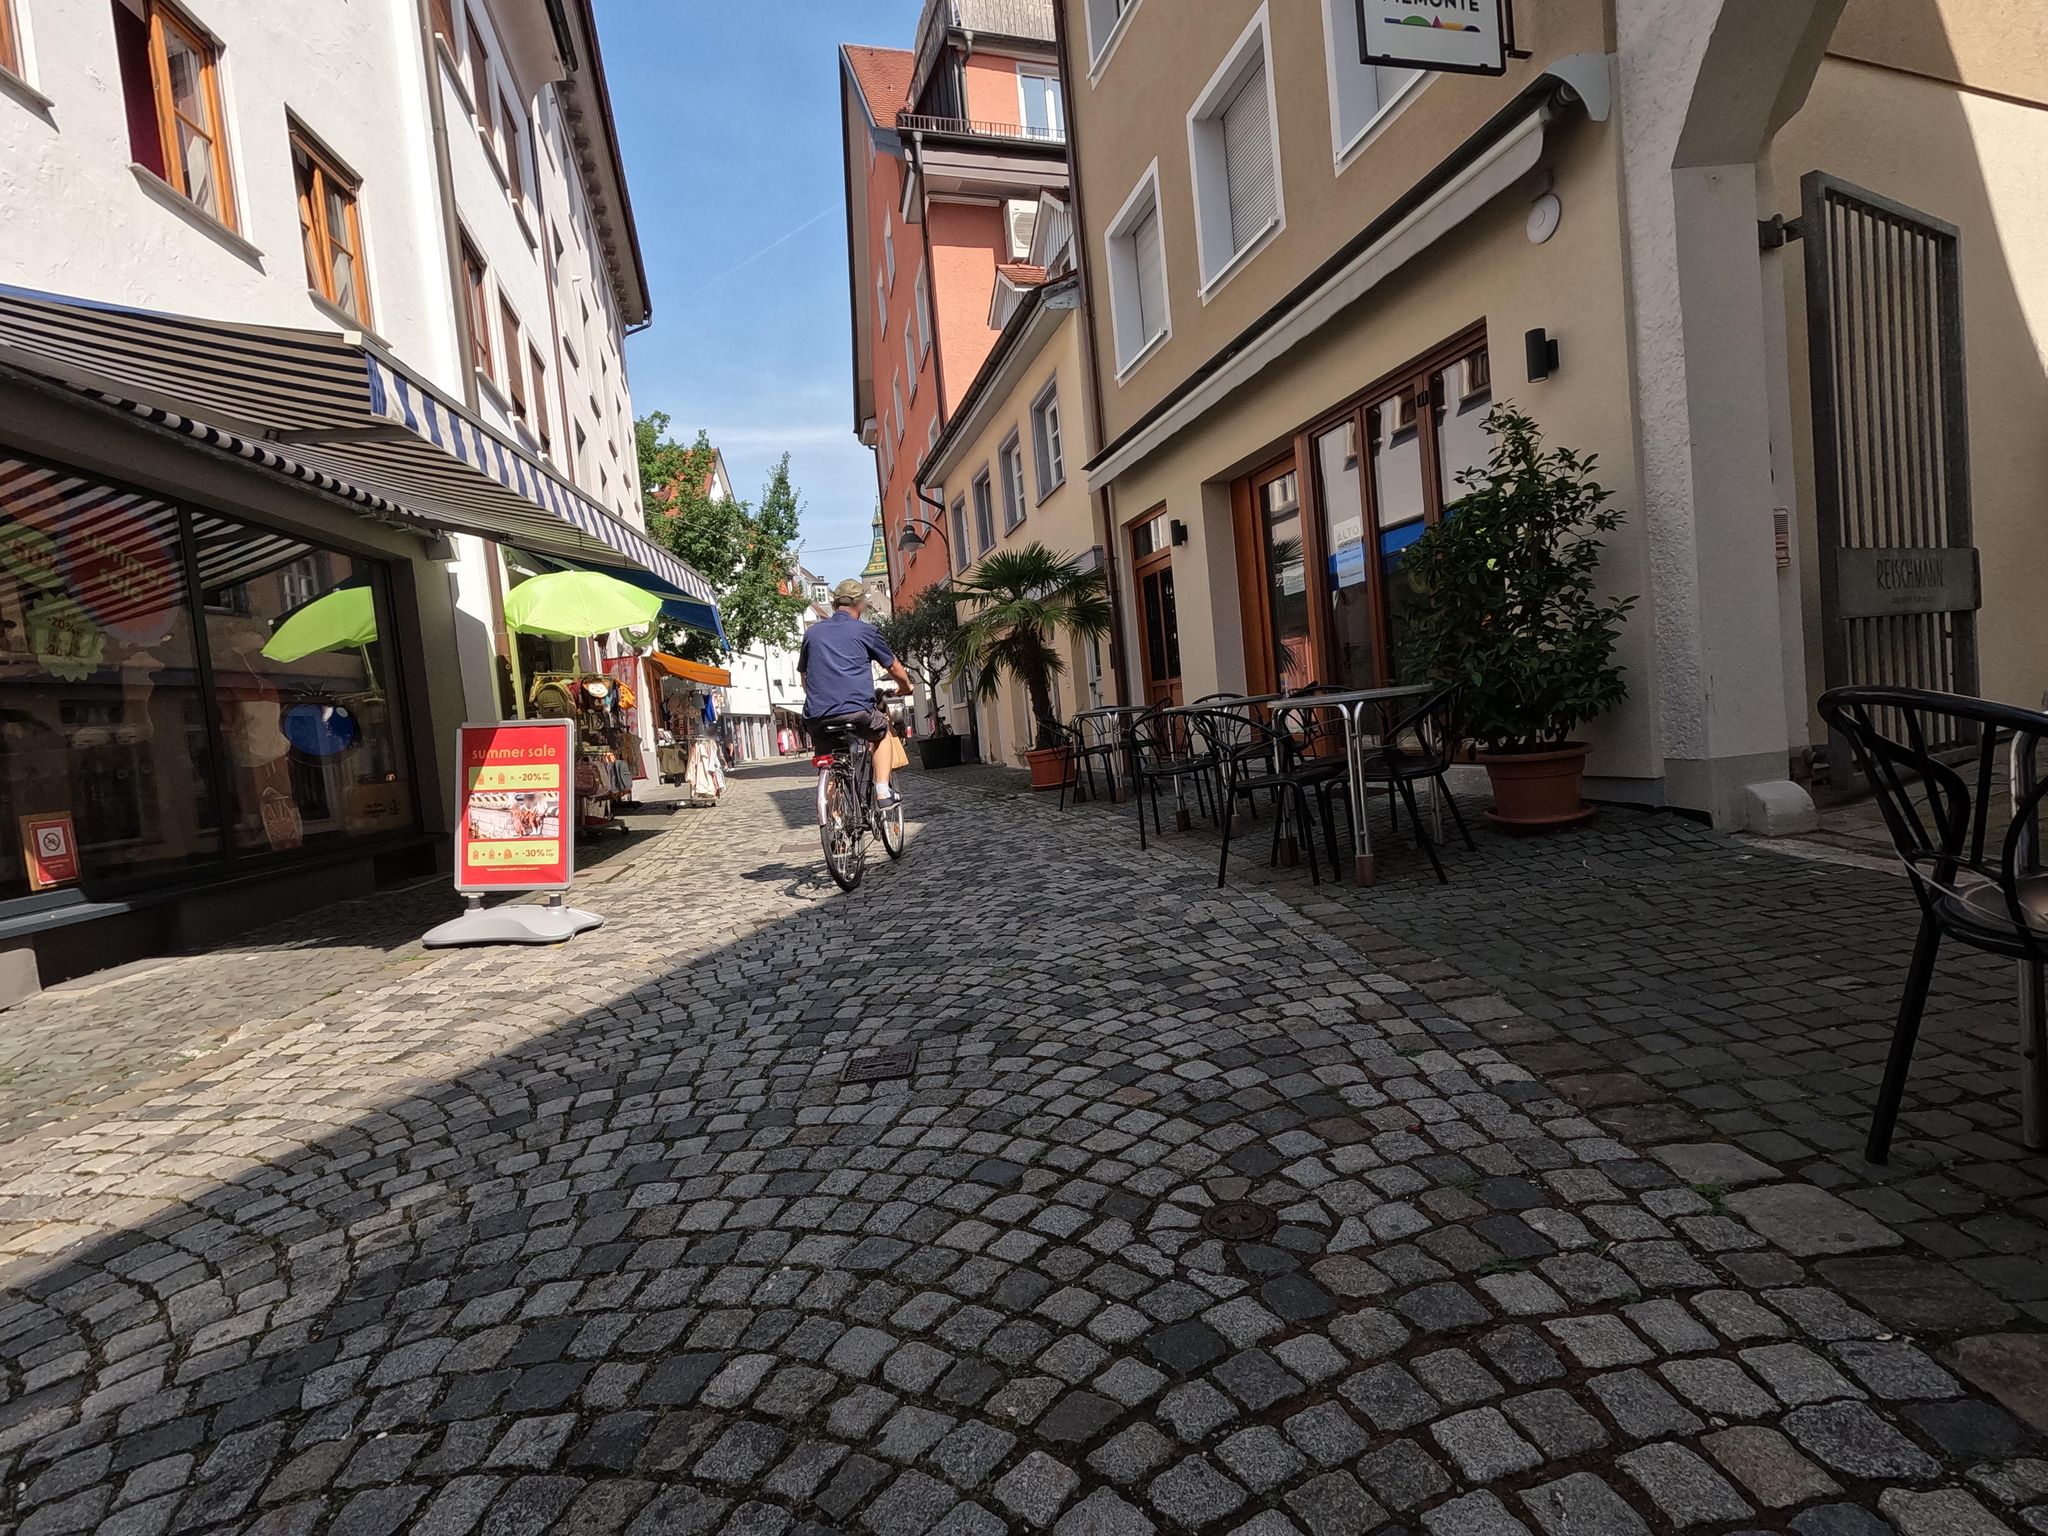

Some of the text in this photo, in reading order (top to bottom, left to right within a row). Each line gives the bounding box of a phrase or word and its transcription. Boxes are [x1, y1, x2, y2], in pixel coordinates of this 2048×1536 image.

[1382, 0, 1480, 12] ONTE
[1337, 525, 1360, 541] ALTO
[81, 529, 164, 588] summer
[1876, 558, 1944, 590] REISCHMANN
[99, 568, 144, 602] sale
[472, 744, 557, 760] summer sale
[518, 772, 542, 782] -20%
[522, 848, 545, 858] -30%
